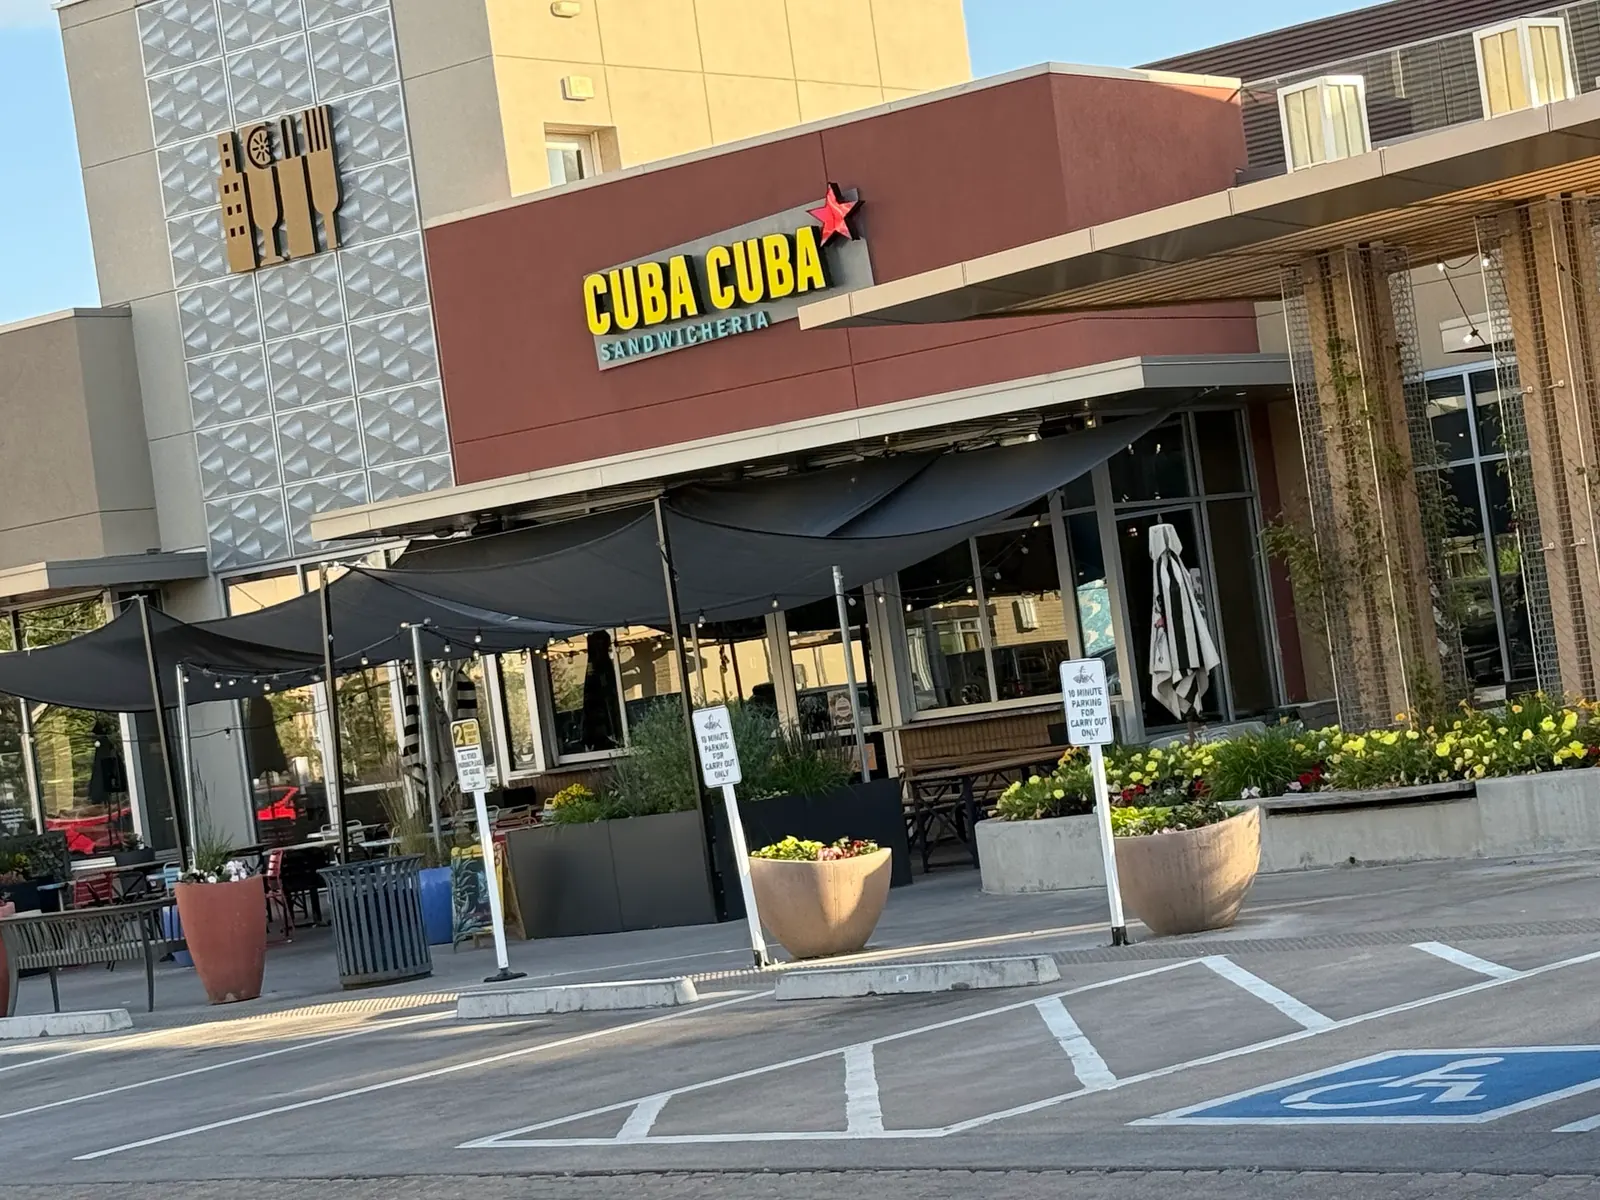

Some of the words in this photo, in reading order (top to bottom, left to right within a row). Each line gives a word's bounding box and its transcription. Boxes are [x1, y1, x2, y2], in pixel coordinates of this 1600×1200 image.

[583, 254, 699, 336] CUBA
[706, 225, 827, 310] CUBA
[600, 310, 769, 362] SANDWICHERIA
[1068, 689, 1076, 698] 10
[1077, 687, 1103, 697] MINUTE
[1071, 698, 1102, 708] PARKING
[1081, 708, 1095, 717] FOR
[1070, 718, 1093, 728] CARRY
[1094, 717, 1108, 726] OUT
[453, 725, 464, 746] 2
[707, 732, 729, 742] MINUTE
[1081, 728, 1100, 737] ONLY
[704, 742, 730, 753] PARKING
[712, 752, 724, 760] FOR
[705, 761, 723, 771] CARRY
[724, 758, 735, 768] OUT
[714, 770, 729, 779] ONLY
